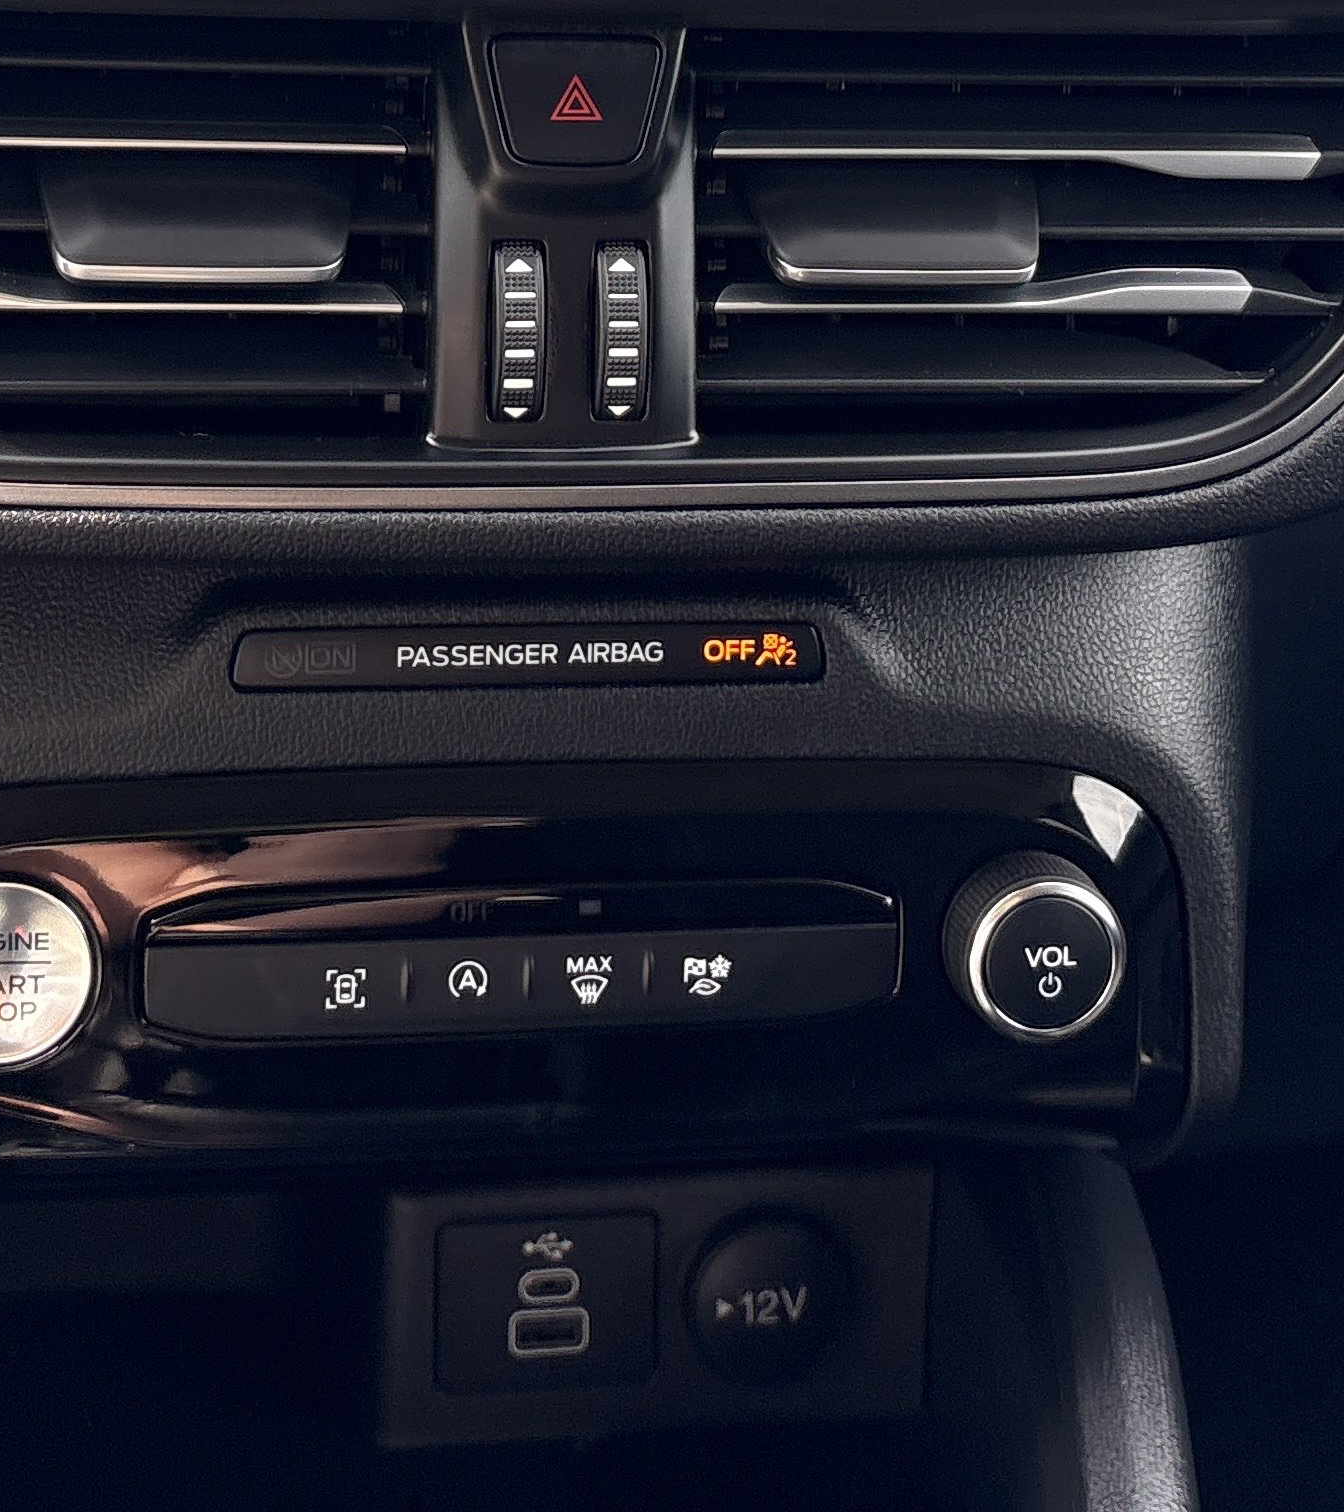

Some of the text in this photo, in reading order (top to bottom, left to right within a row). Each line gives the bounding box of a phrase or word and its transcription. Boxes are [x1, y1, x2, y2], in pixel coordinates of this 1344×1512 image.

[310, 647, 351, 668] ON
[397, 641, 664, 668] PASSENGER AIRBAG
[703, 639, 756, 662] OFF
[566, 955, 613, 974] MAX
[1024, 945, 1077, 968] VOL
[742, 1286, 807, 1325] 12V
